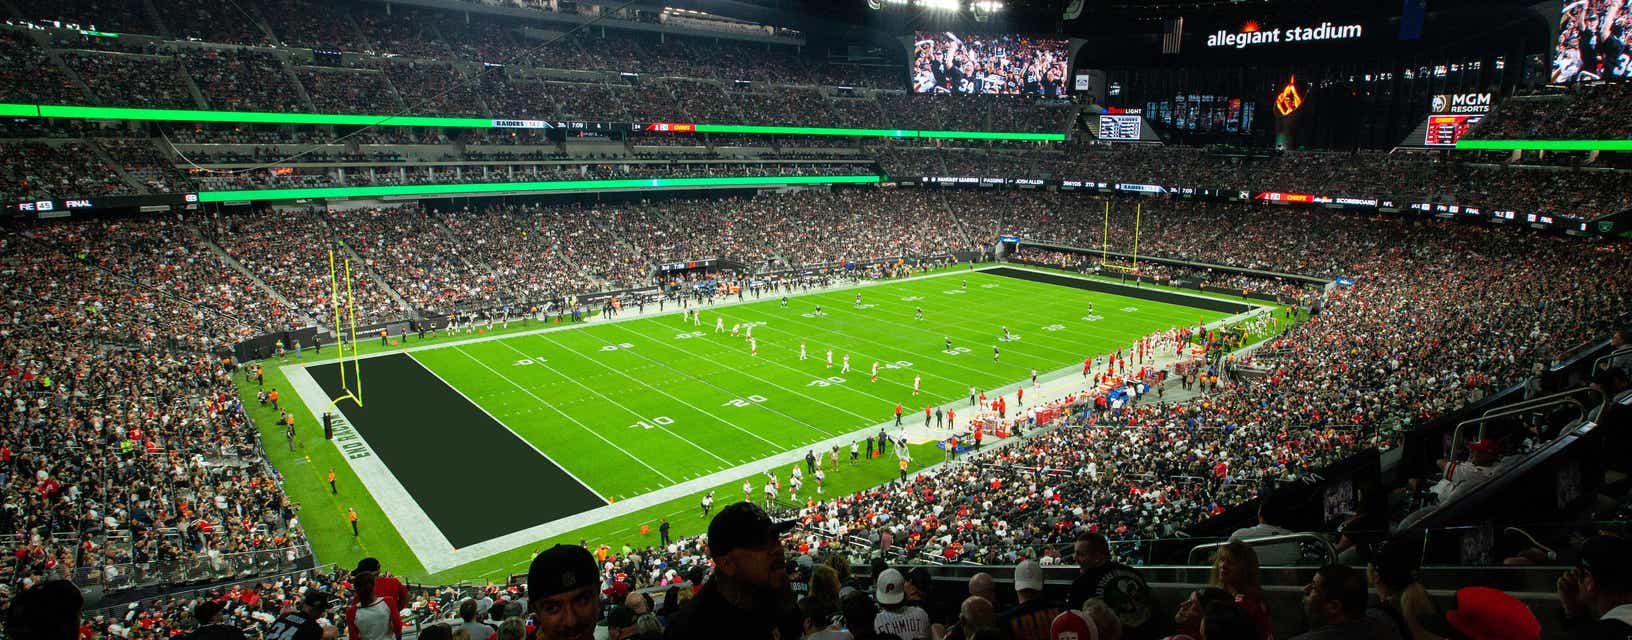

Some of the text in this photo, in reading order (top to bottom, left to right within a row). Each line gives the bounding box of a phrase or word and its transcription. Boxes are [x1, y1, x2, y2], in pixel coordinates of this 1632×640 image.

[1207, 22, 1363, 48] allegiant stadium
[1452, 93, 1491, 106] MGM
[1451, 105, 1490, 113] RESORTS
[66, 200, 92, 208] FINAL
[1336, 198, 1376, 207] SCOREBOARD
[810, 375, 847, 387] 30
[728, 394, 769, 408] 20
[635, 415, 676, 430] 10
[342, 441, 371, 460] END
